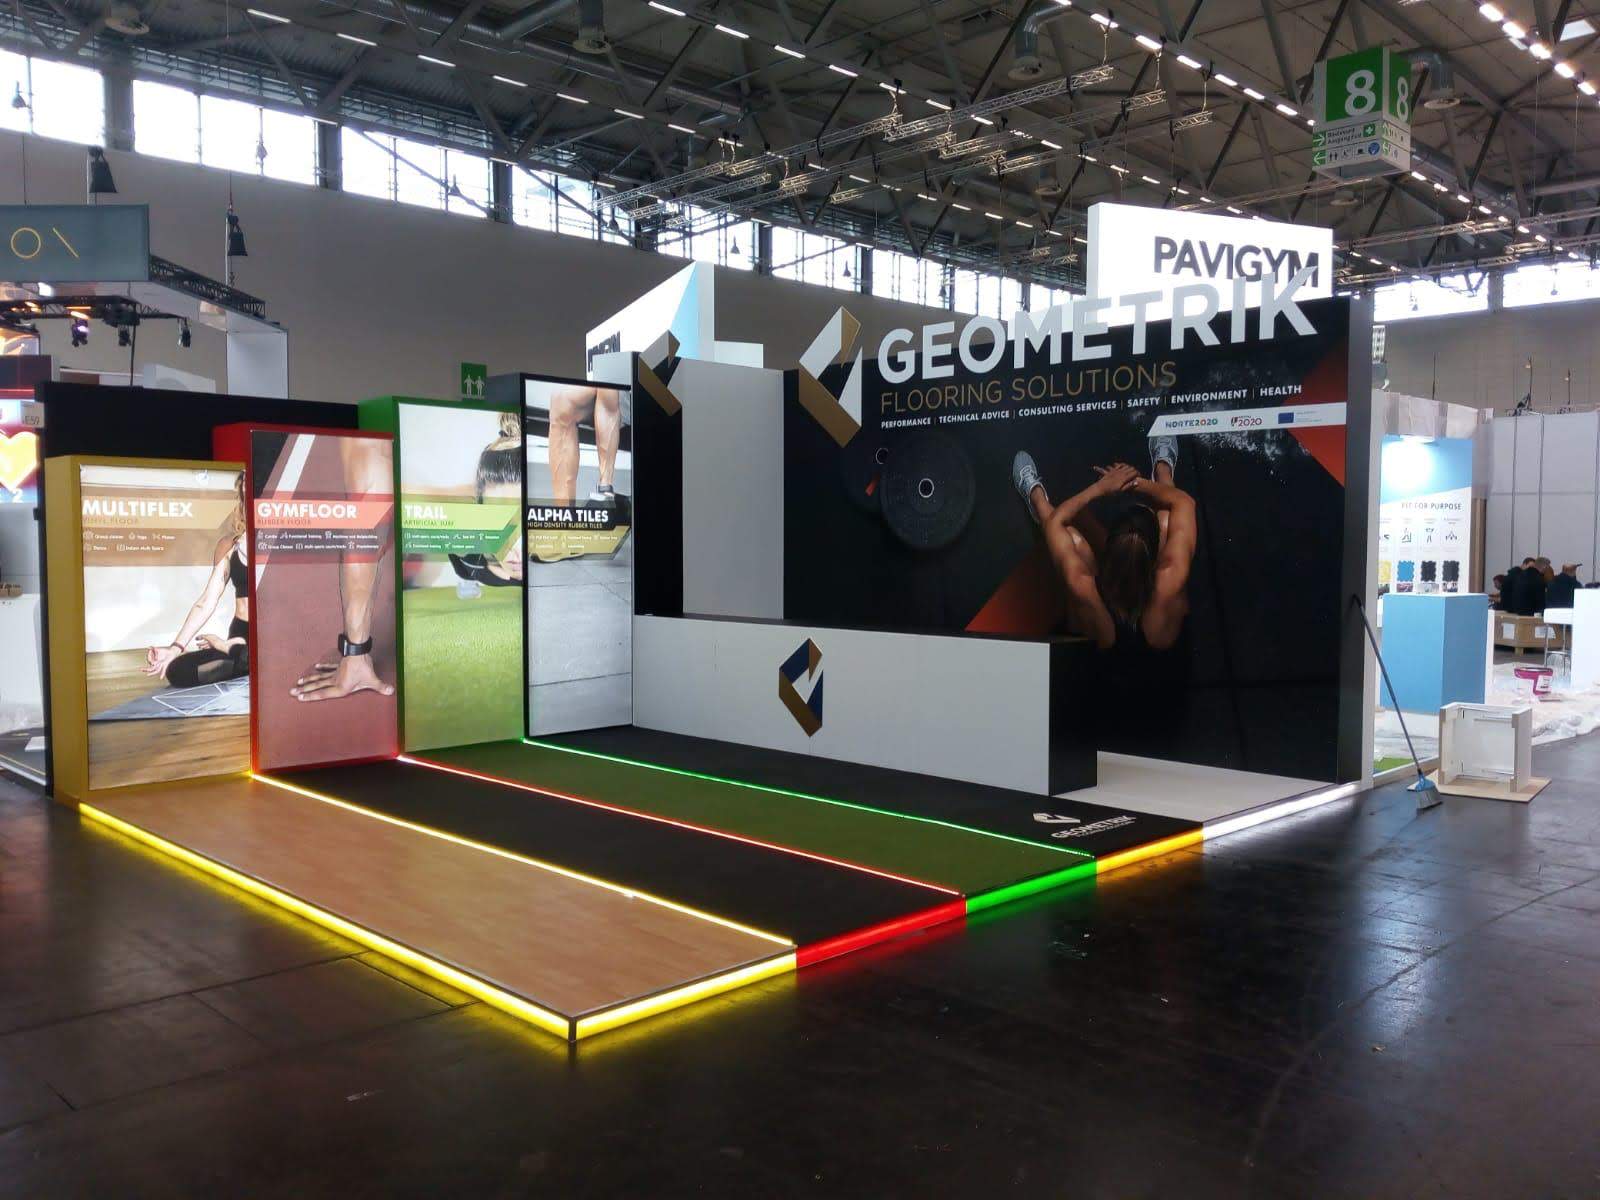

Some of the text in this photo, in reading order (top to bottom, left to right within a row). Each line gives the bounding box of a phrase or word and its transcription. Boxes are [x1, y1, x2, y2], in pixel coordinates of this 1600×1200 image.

[1344, 69, 1377, 116] 8
[1396, 76, 1409, 122] 8
[1153, 236, 1319, 288] PAVIGYM
[877, 265, 1318, 384] GEOMETRIK
[880, 361, 1178, 414] FLOORING SOLUTIONS
[880, 384, 1303, 429] PERFORMANCE TECHNICAL ADVICE CONSULTING SERVICES SAFETY ENVIRONMENT HEALTH
[1238, 417, 1263, 427] 2020
[82, 499, 193, 518] MULTIFLEX
[257, 502, 357, 519] GYMFLOOR
[404, 504, 448, 520] TRAIL
[527, 508, 609, 523] ALPHA TILES
